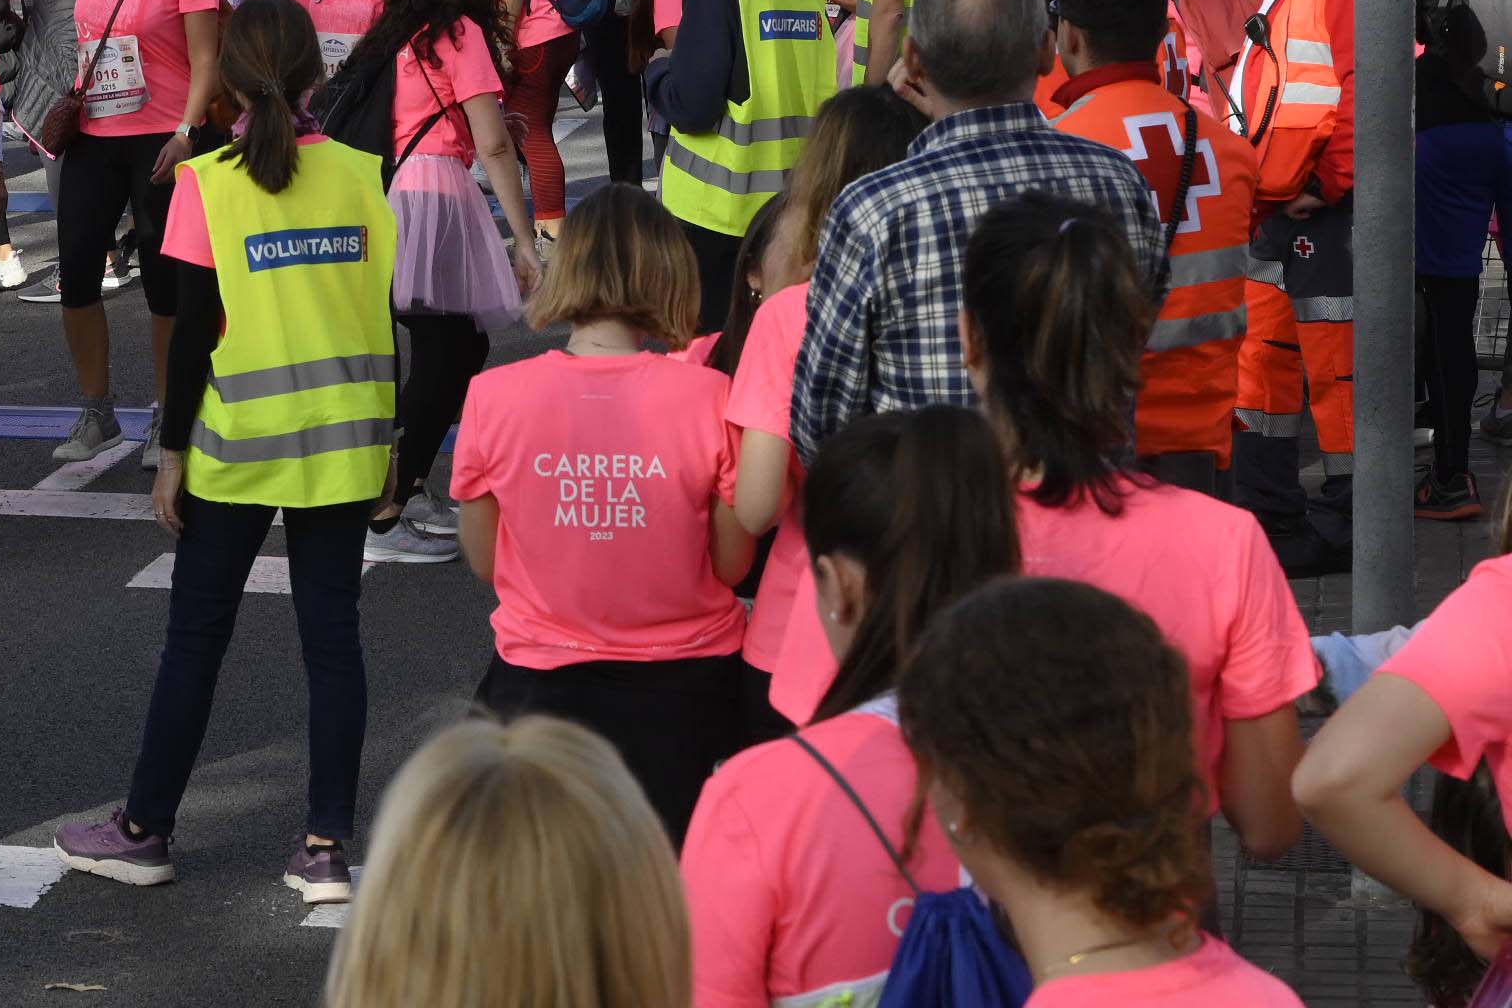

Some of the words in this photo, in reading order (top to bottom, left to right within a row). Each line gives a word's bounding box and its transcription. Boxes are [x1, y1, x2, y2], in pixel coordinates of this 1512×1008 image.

[96, 69, 119, 82] 016
[101, 83, 116, 92] 8215
[250, 234, 361, 262] VOLUNTARIS
[534, 454, 666, 479] CARRERA
[560, 480, 597, 503] DE
[606, 480, 640, 503] LA
[554, 505, 646, 528] MUJER
[589, 531, 613, 541] 2023
